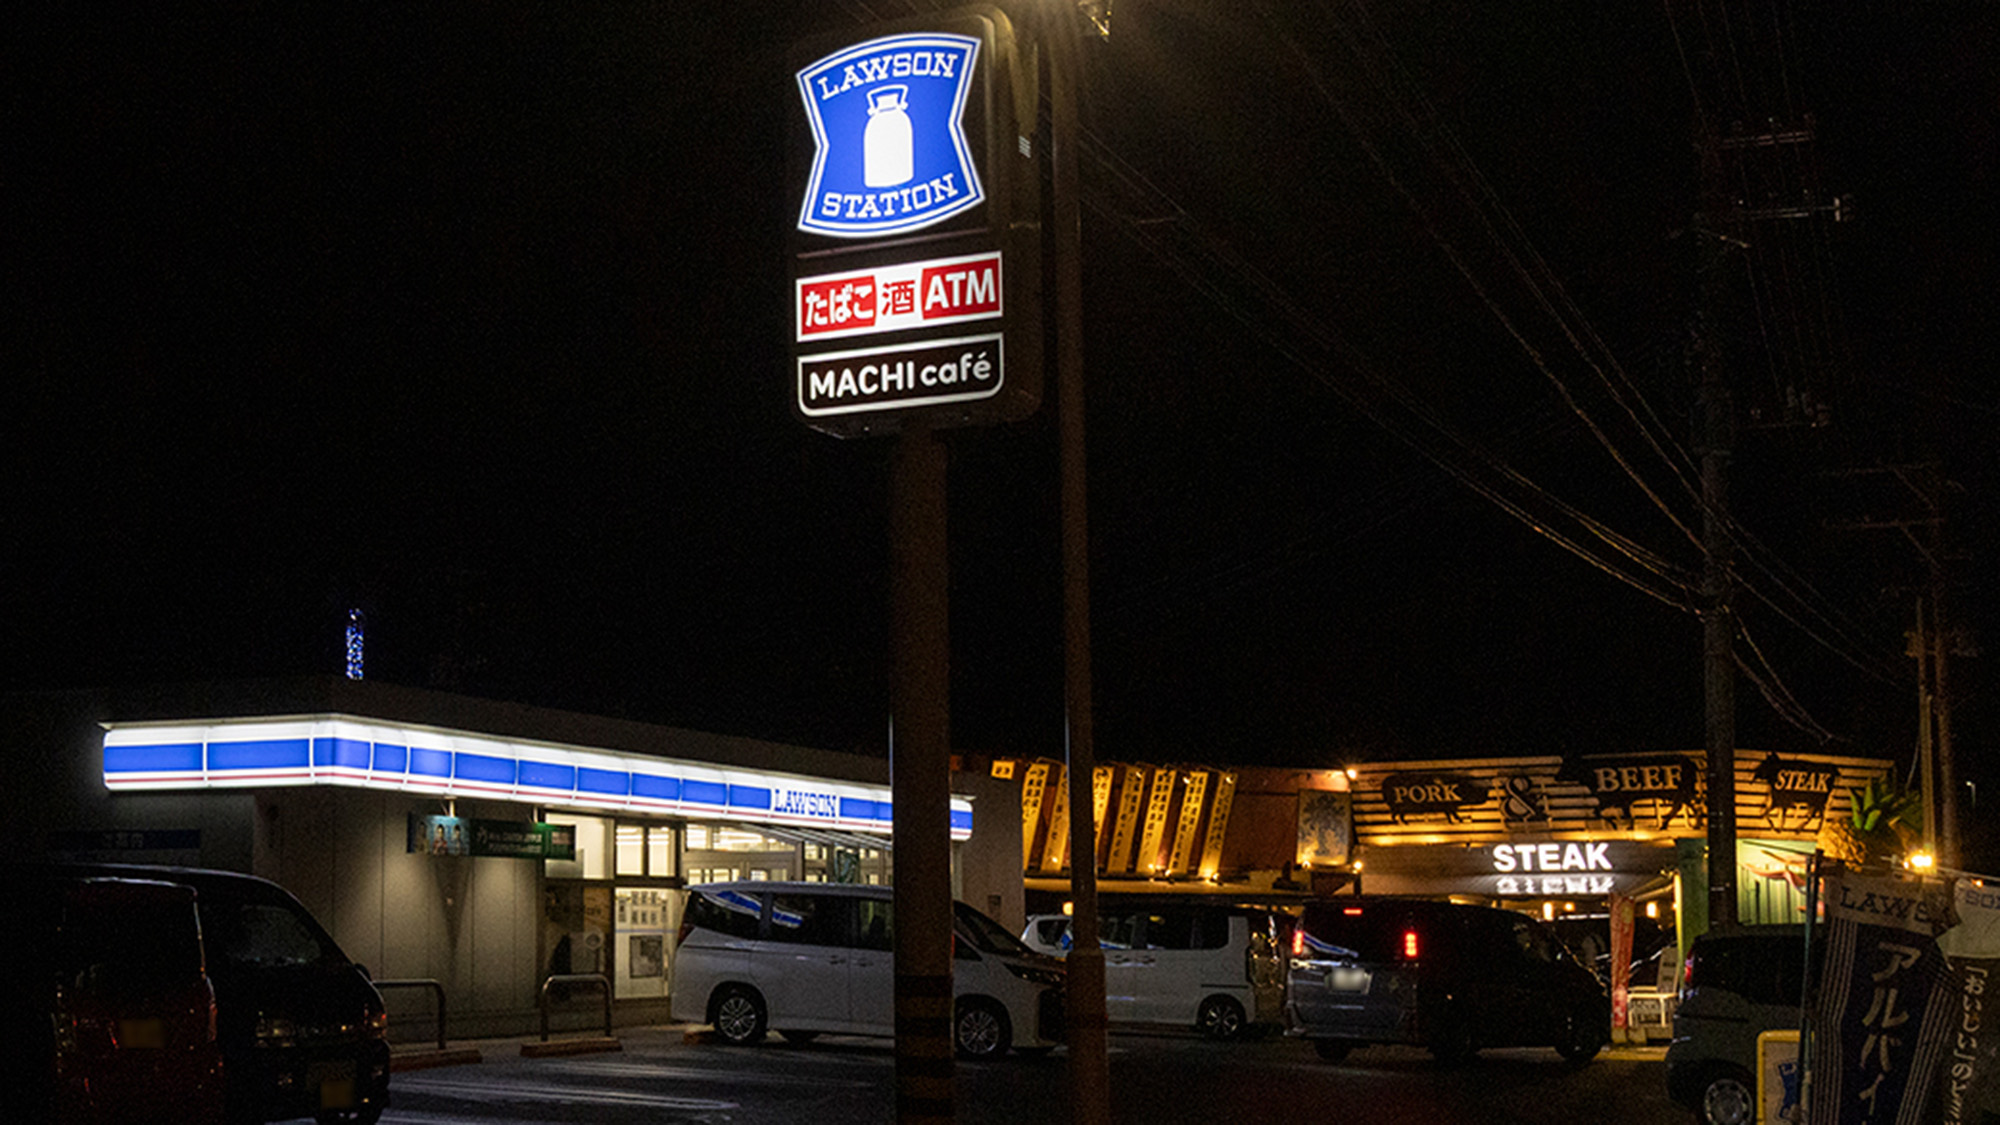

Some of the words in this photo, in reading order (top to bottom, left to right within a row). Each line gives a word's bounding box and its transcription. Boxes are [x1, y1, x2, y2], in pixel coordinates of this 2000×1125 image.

[817, 52, 958, 100] LAWSON
[821, 173, 958, 218] STATION
[805, 283, 874, 327] たばこ
[881, 279, 915, 317] 酒
[925, 267, 996, 312] ATM
[809, 360, 915, 400] MACHI
[920, 351, 991, 386] café
[1394, 782, 1462, 804] PORK
[1594, 764, 1682, 792] BEEF
[1774, 769, 1832, 792] STEAK
[774, 788, 837, 817] LAWSON
[1493, 843, 1612, 872] STEAK
